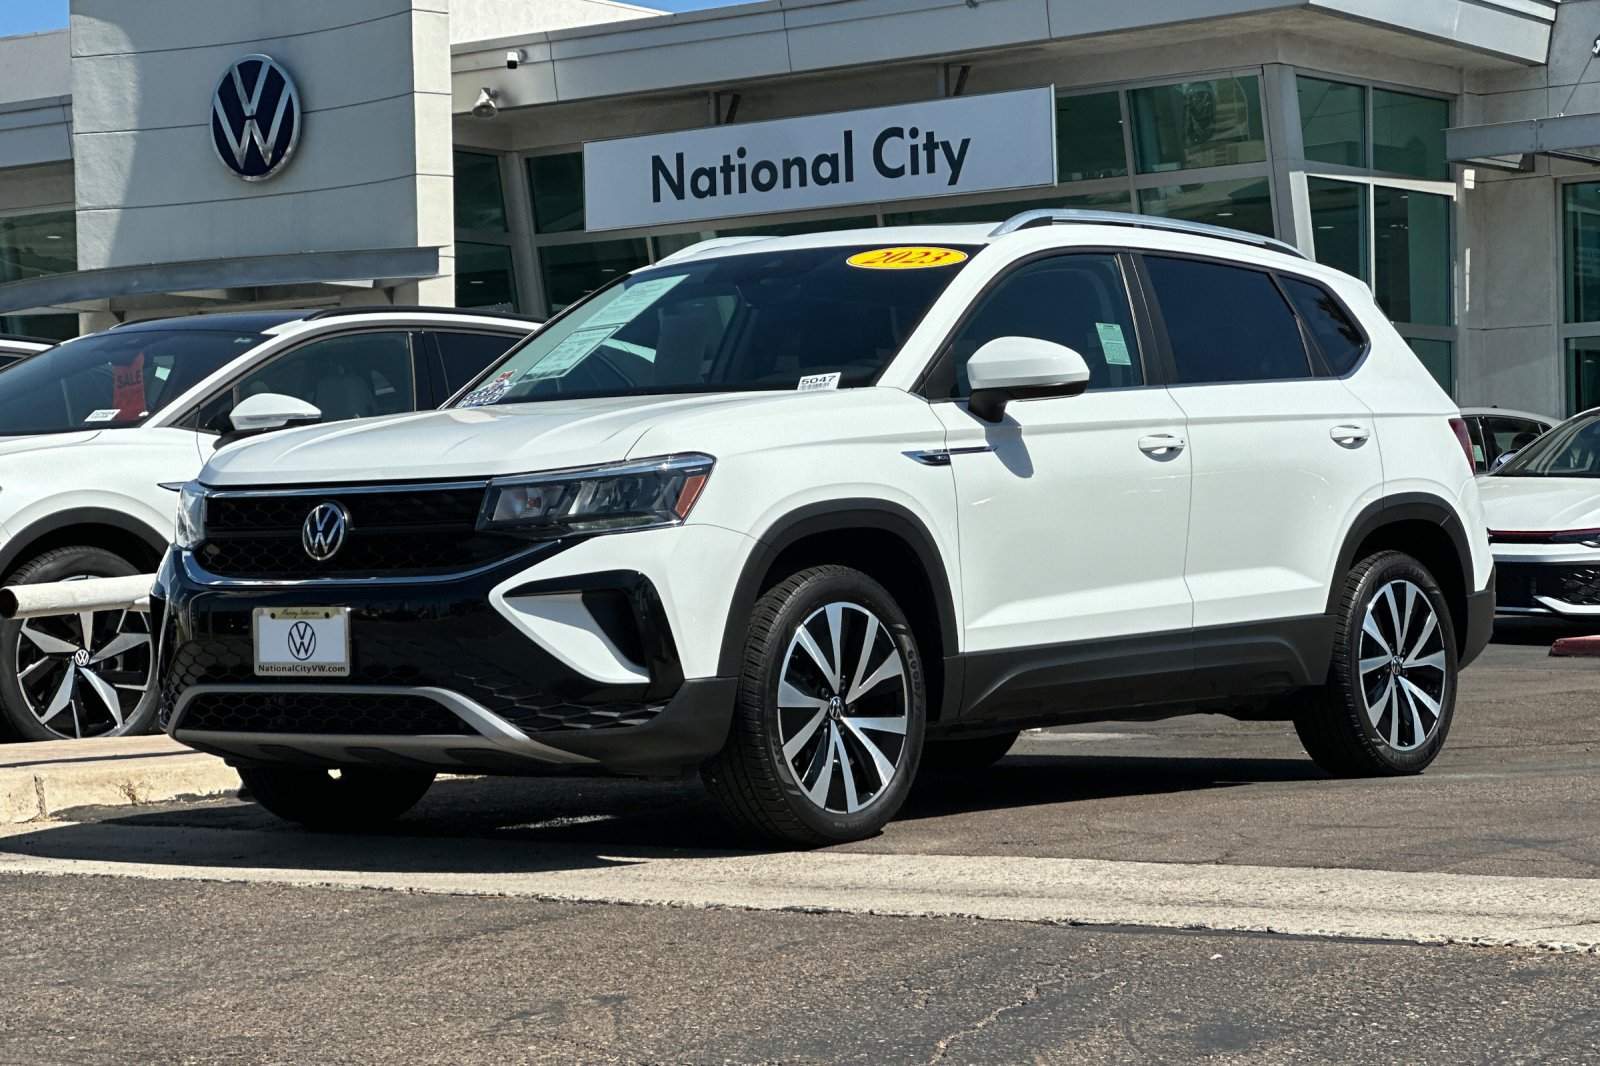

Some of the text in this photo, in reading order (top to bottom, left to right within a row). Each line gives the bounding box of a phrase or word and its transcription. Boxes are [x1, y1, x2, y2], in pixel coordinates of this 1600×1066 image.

[651, 126, 972, 203] National City
[860, 250, 952, 265] 2023
[117, 368, 142, 389] SALE
[801, 375, 837, 385] 5047
[258, 664, 346, 674] NationalCityVW.com
